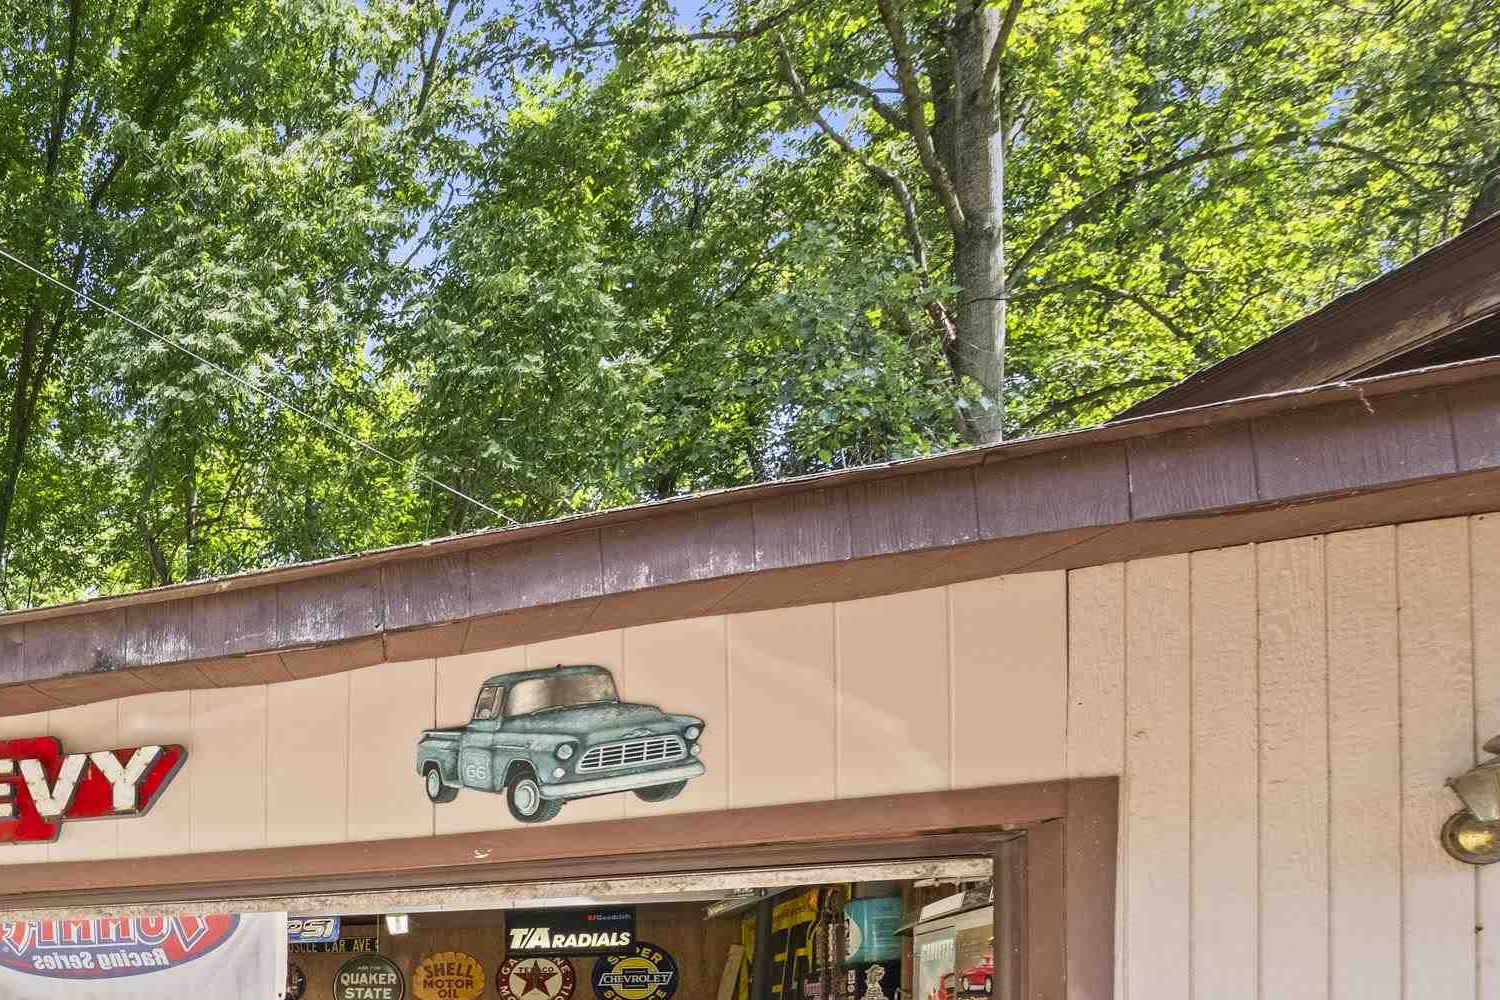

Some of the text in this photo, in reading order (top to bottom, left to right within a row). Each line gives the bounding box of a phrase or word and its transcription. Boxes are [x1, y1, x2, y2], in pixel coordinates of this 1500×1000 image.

[287, 918, 334, 939] PSI
[287, 938, 373, 953] USCLE CAR AVE
[509, 927, 632, 950] T/A RADIALS
[607, 947, 664, 966] SER
[423, 961, 474, 978] SHELL
[516, 966, 555, 974] TECO
[340, 972, 397, 986] QUAKER
[423, 979, 474, 989] MOTOR
[602, 973, 669, 984] CHEVROLET
[344, 987, 392, 1000] STATE
[437, 988, 460, 999] OIL
